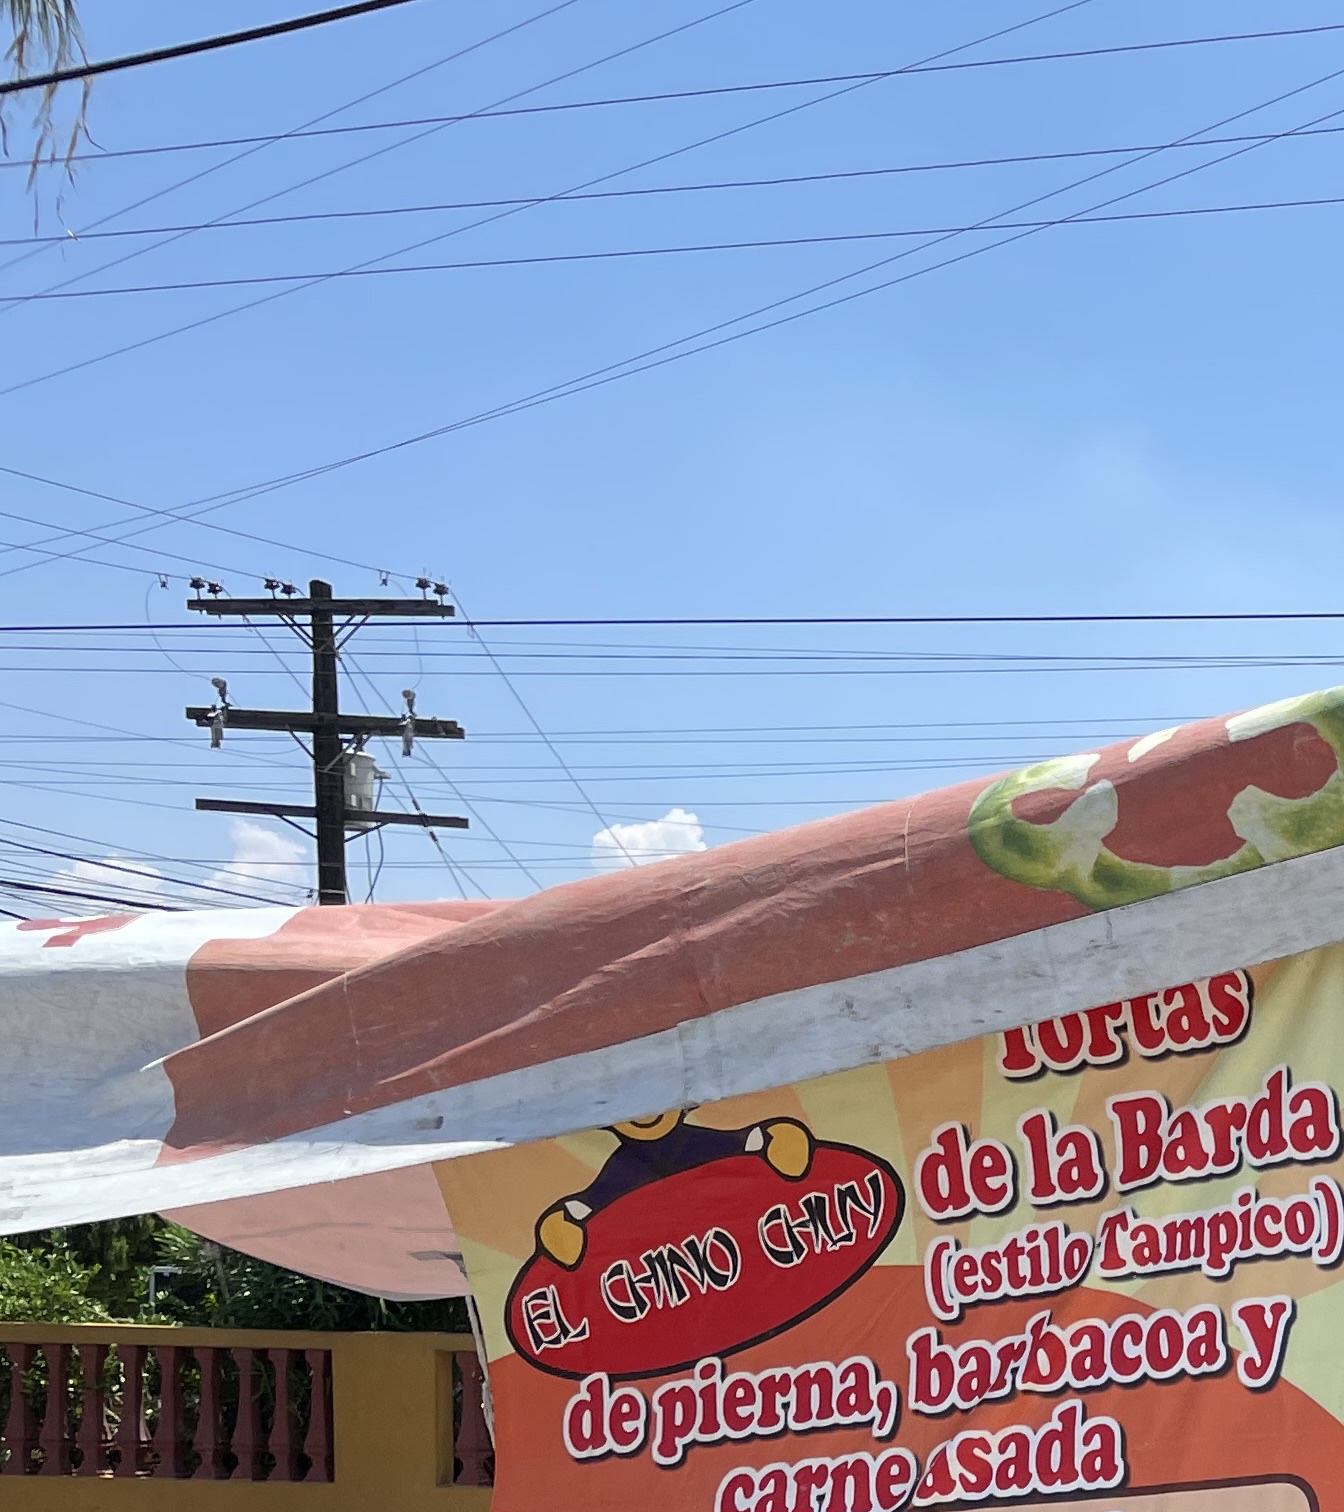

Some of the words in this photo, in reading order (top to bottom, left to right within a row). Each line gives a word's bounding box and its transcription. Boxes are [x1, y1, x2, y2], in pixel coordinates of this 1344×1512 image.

[918, 1124, 1010, 1217] de
[1019, 1111, 1102, 1201] la
[1109, 1068, 1338, 1187] Barda
[521, 1284, 590, 1355] EL
[600, 1226, 742, 1324] CHINO
[757, 1169, 886, 1269] CHUY
[927, 1223, 1092, 1317] (estilo
[1095, 1178, 1342, 1274] Tampico)
[566, 1376, 643, 1455] de
[654, 1359, 895, 1461] pierna,
[908, 1311, 1223, 1409] barbacoa
[1235, 1299, 1290, 1382] y
[914, 1401, 1121, 1503] asada
